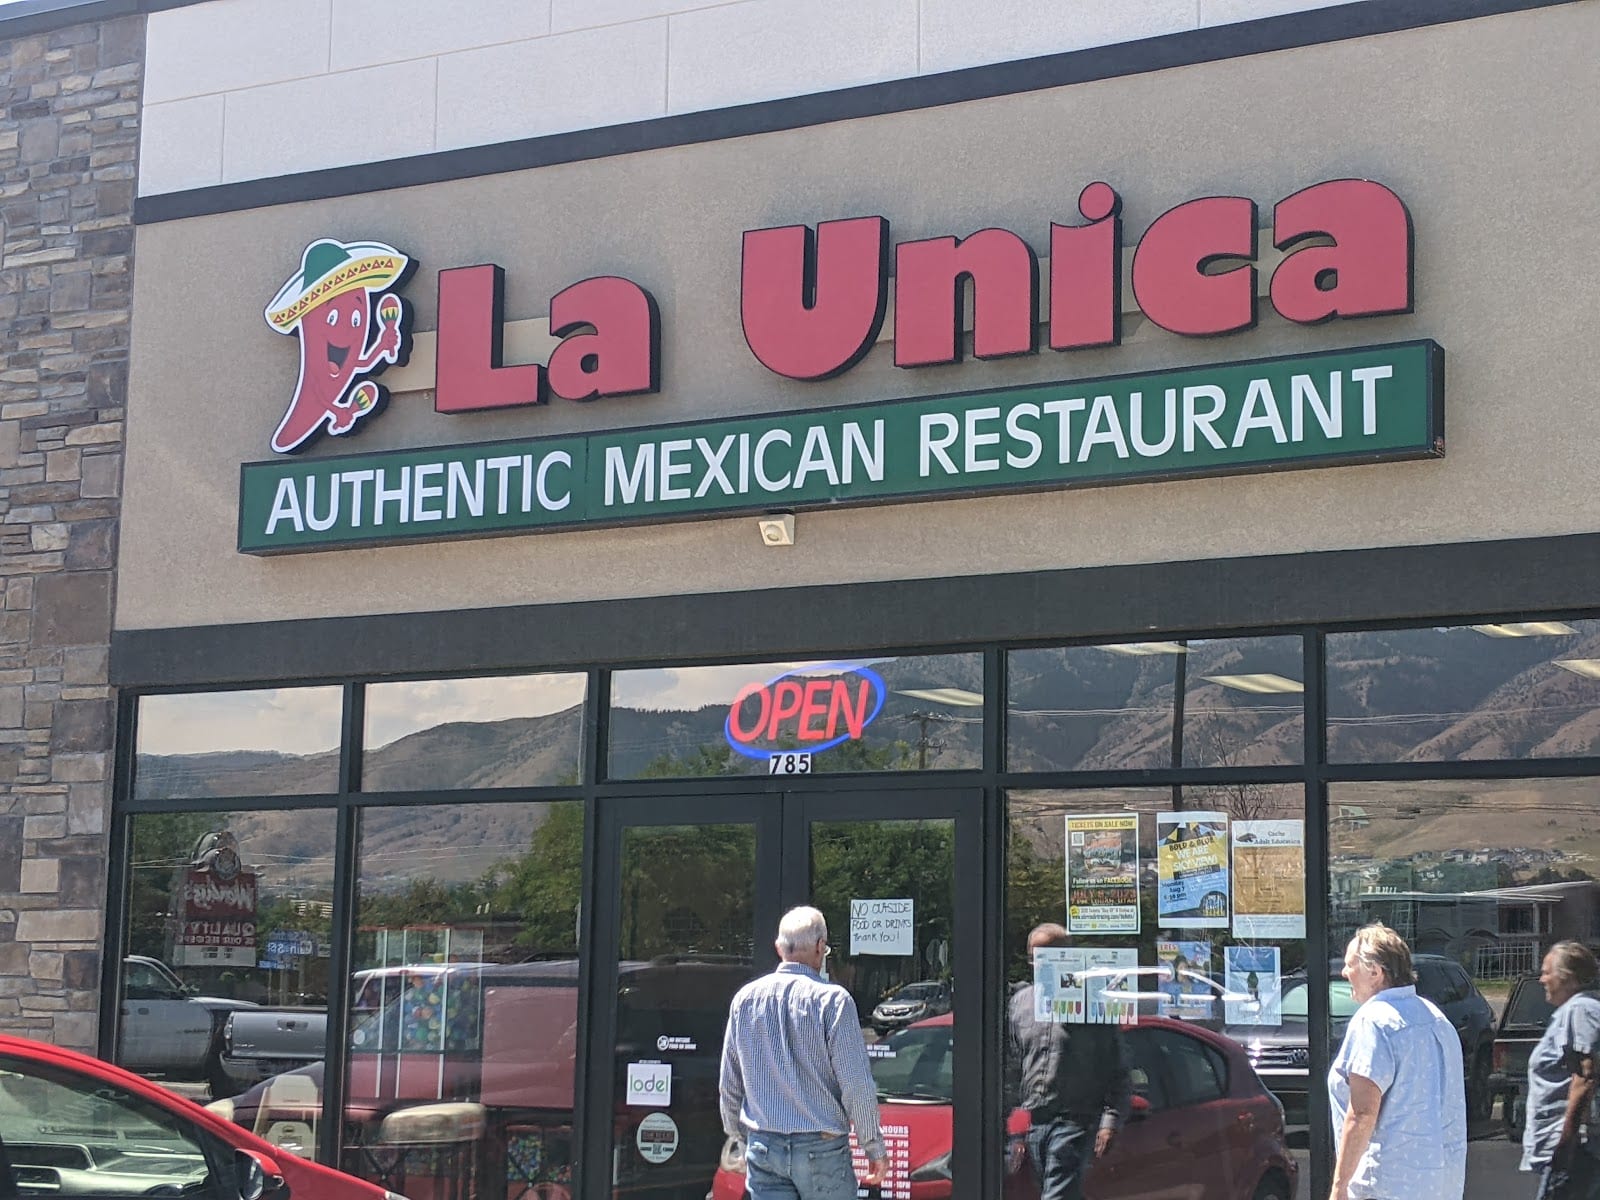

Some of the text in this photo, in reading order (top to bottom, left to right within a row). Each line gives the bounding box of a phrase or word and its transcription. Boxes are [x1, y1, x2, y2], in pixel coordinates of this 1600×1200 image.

[435, 179, 1413, 413] La Unica
[264, 365, 1393, 535] AUTHENTIC MEXICAN RESTAURANT
[729, 680, 870, 743] OPEN
[771, 754, 810, 774] 785
[1104, 820, 1118, 828] SALE
[1168, 842, 1188, 852] BOLD
[1175, 845, 1209, 860] WE ARE
[852, 902, 869, 918] NO
[852, 919, 870, 931] FOOD
[871, 920, 882, 929] OR
[882, 1126, 909, 1134] HOURS
